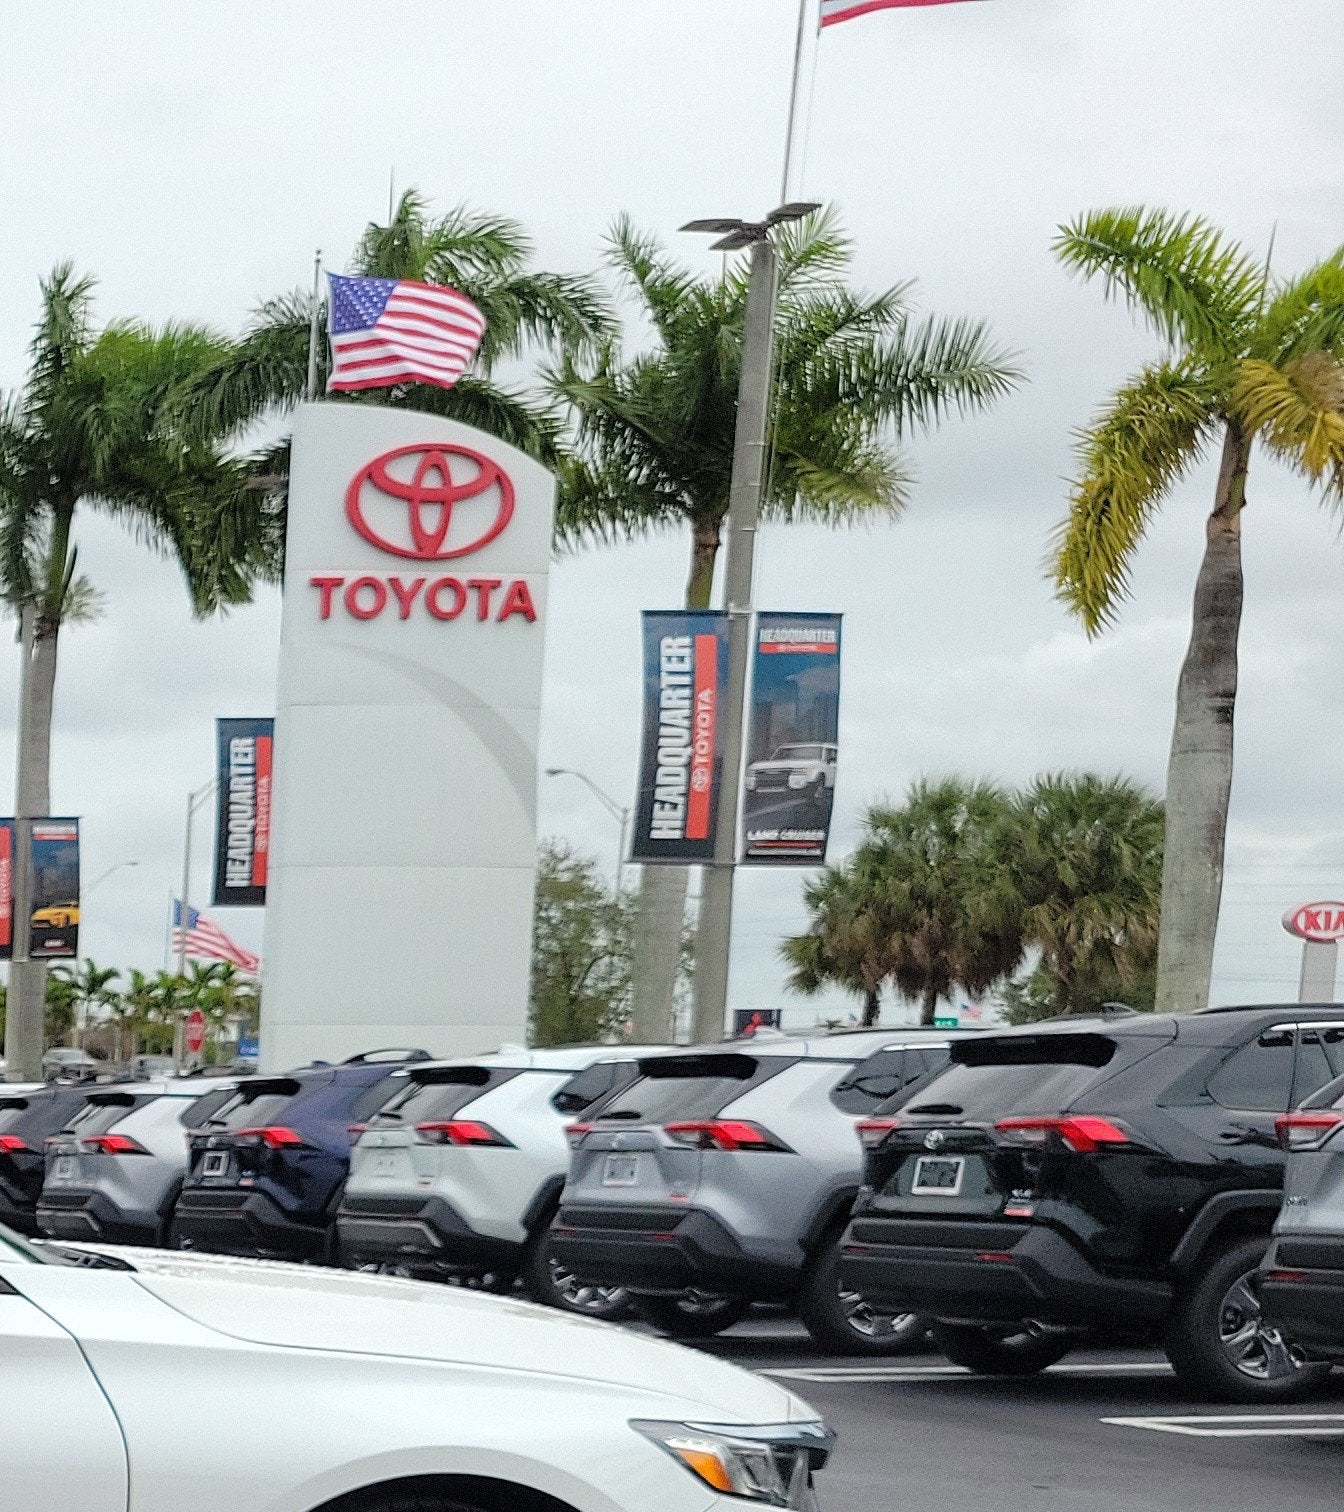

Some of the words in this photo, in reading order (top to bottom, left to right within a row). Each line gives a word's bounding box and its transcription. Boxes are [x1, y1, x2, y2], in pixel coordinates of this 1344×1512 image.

[310, 576, 537, 621] TOYOTA
[650, 635, 694, 839] HEADQUARTER
[694, 688, 713, 763] TOYOTA
[225, 737, 255, 887] HEADQUARTER
